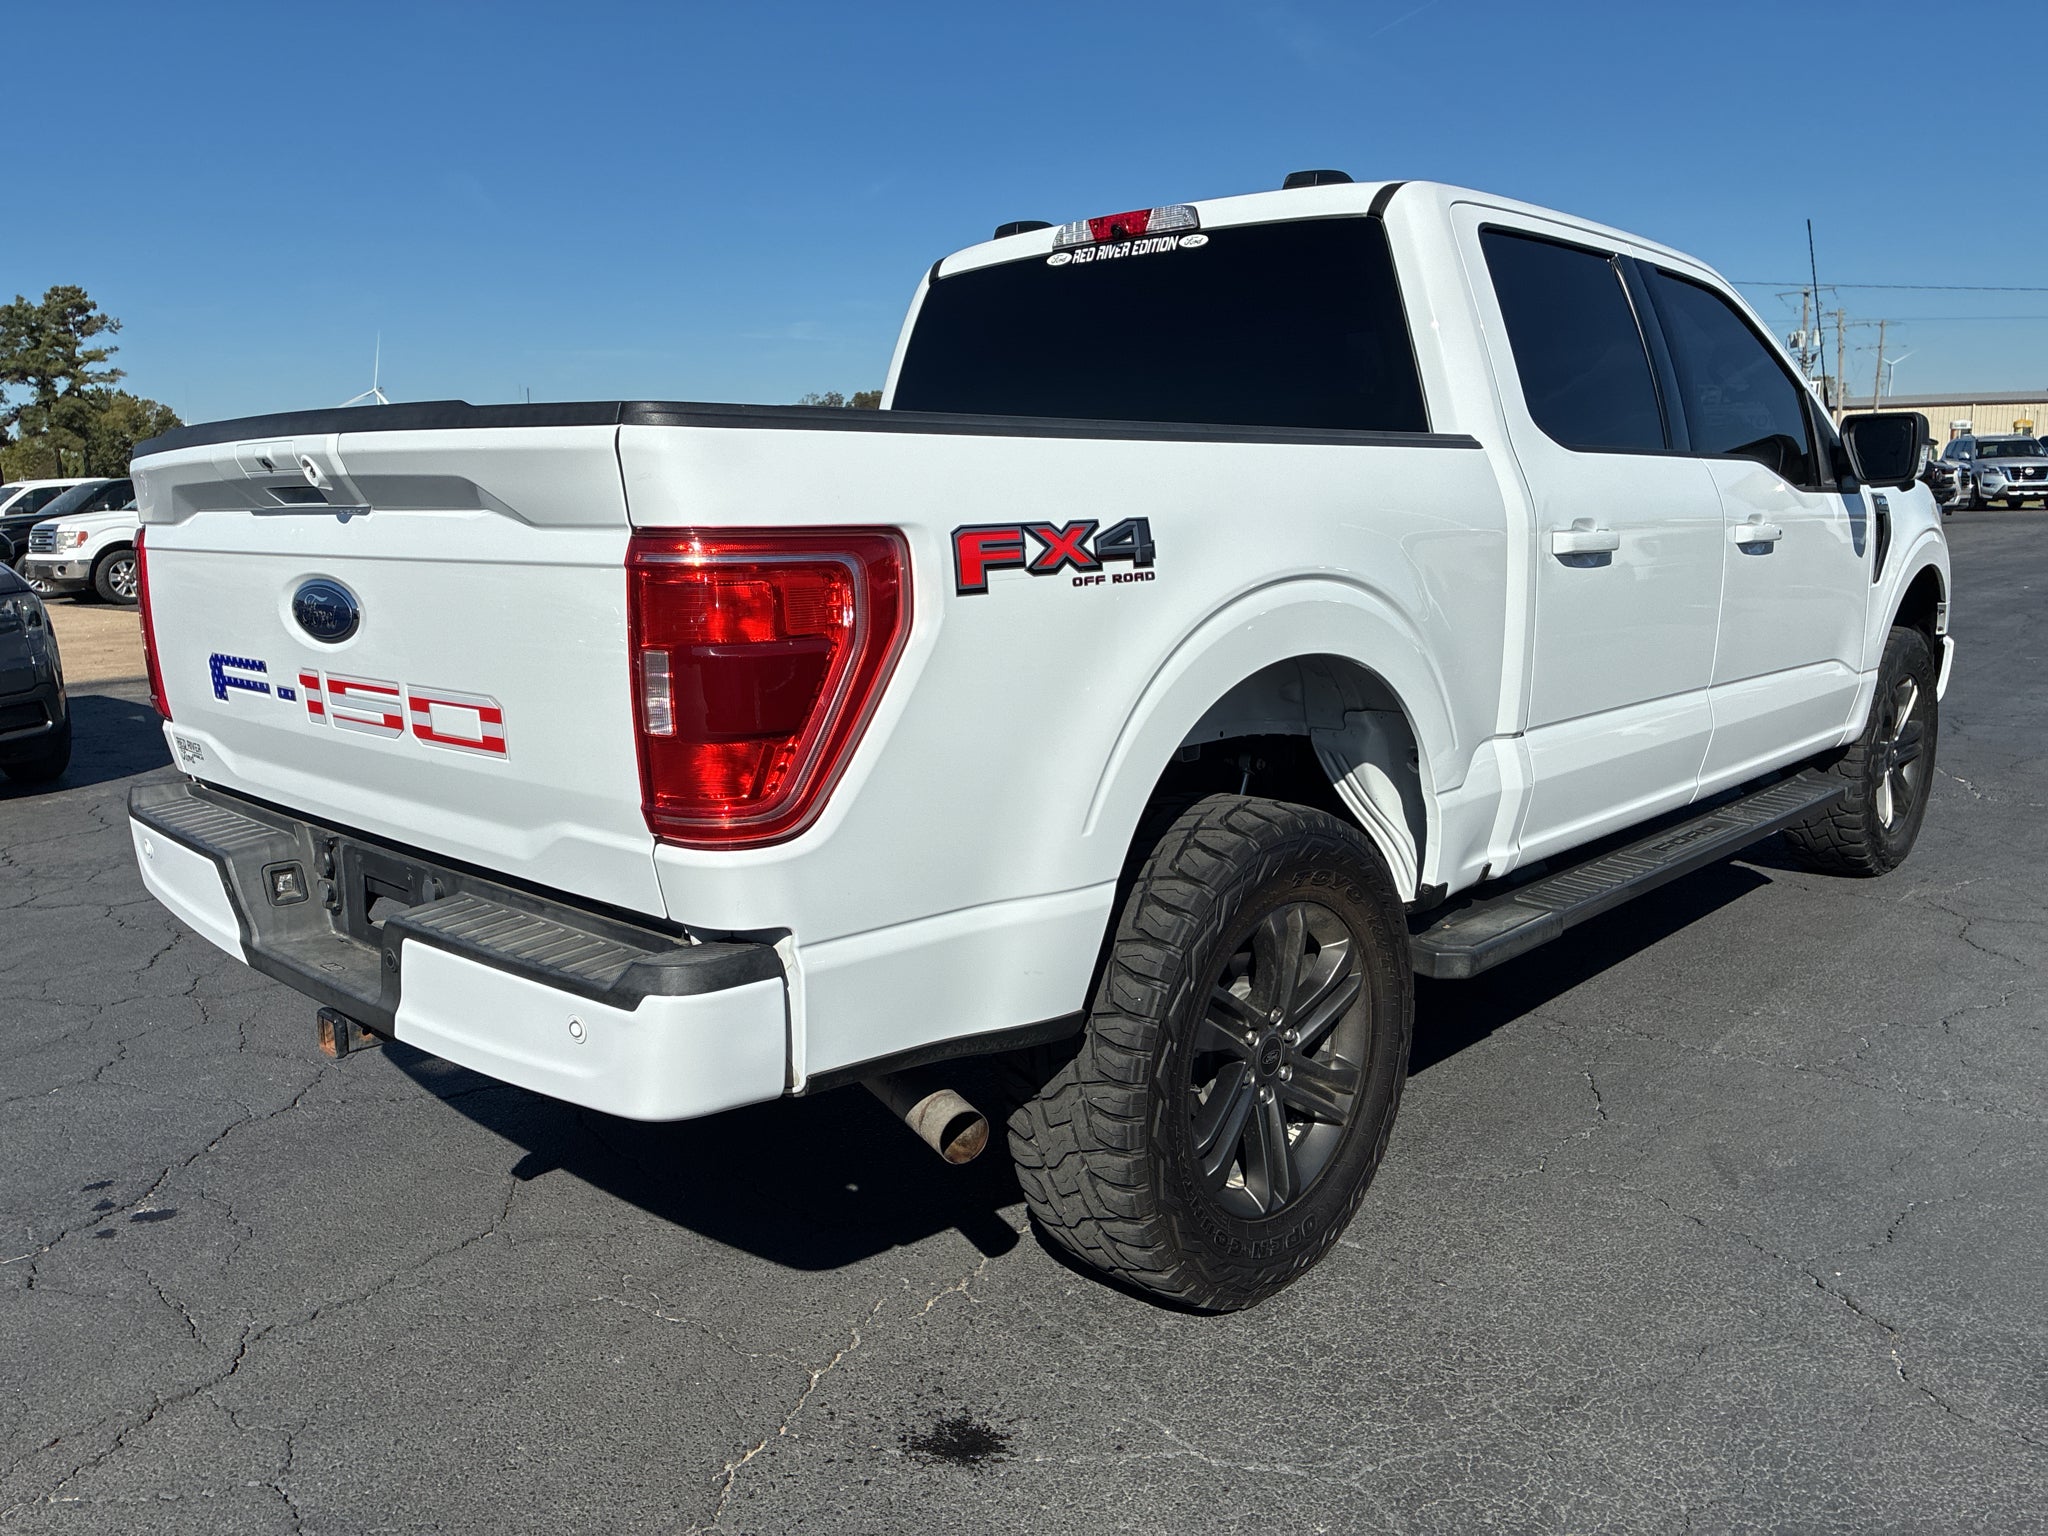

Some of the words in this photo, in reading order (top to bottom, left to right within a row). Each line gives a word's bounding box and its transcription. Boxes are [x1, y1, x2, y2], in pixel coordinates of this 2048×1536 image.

[1072, 247, 1096, 264] RED
[1096, 241, 1131, 260] RIVER
[1131, 235, 1179, 255] EDITION
[950, 516, 1157, 597] FX4
[1072, 574, 1106, 587] OFF
[1112, 571, 1156, 584] ROAD
[208, 651, 509, 762] F-150
[1651, 825, 1718, 851] FORD
[1291, 867, 1366, 904] TOYO
